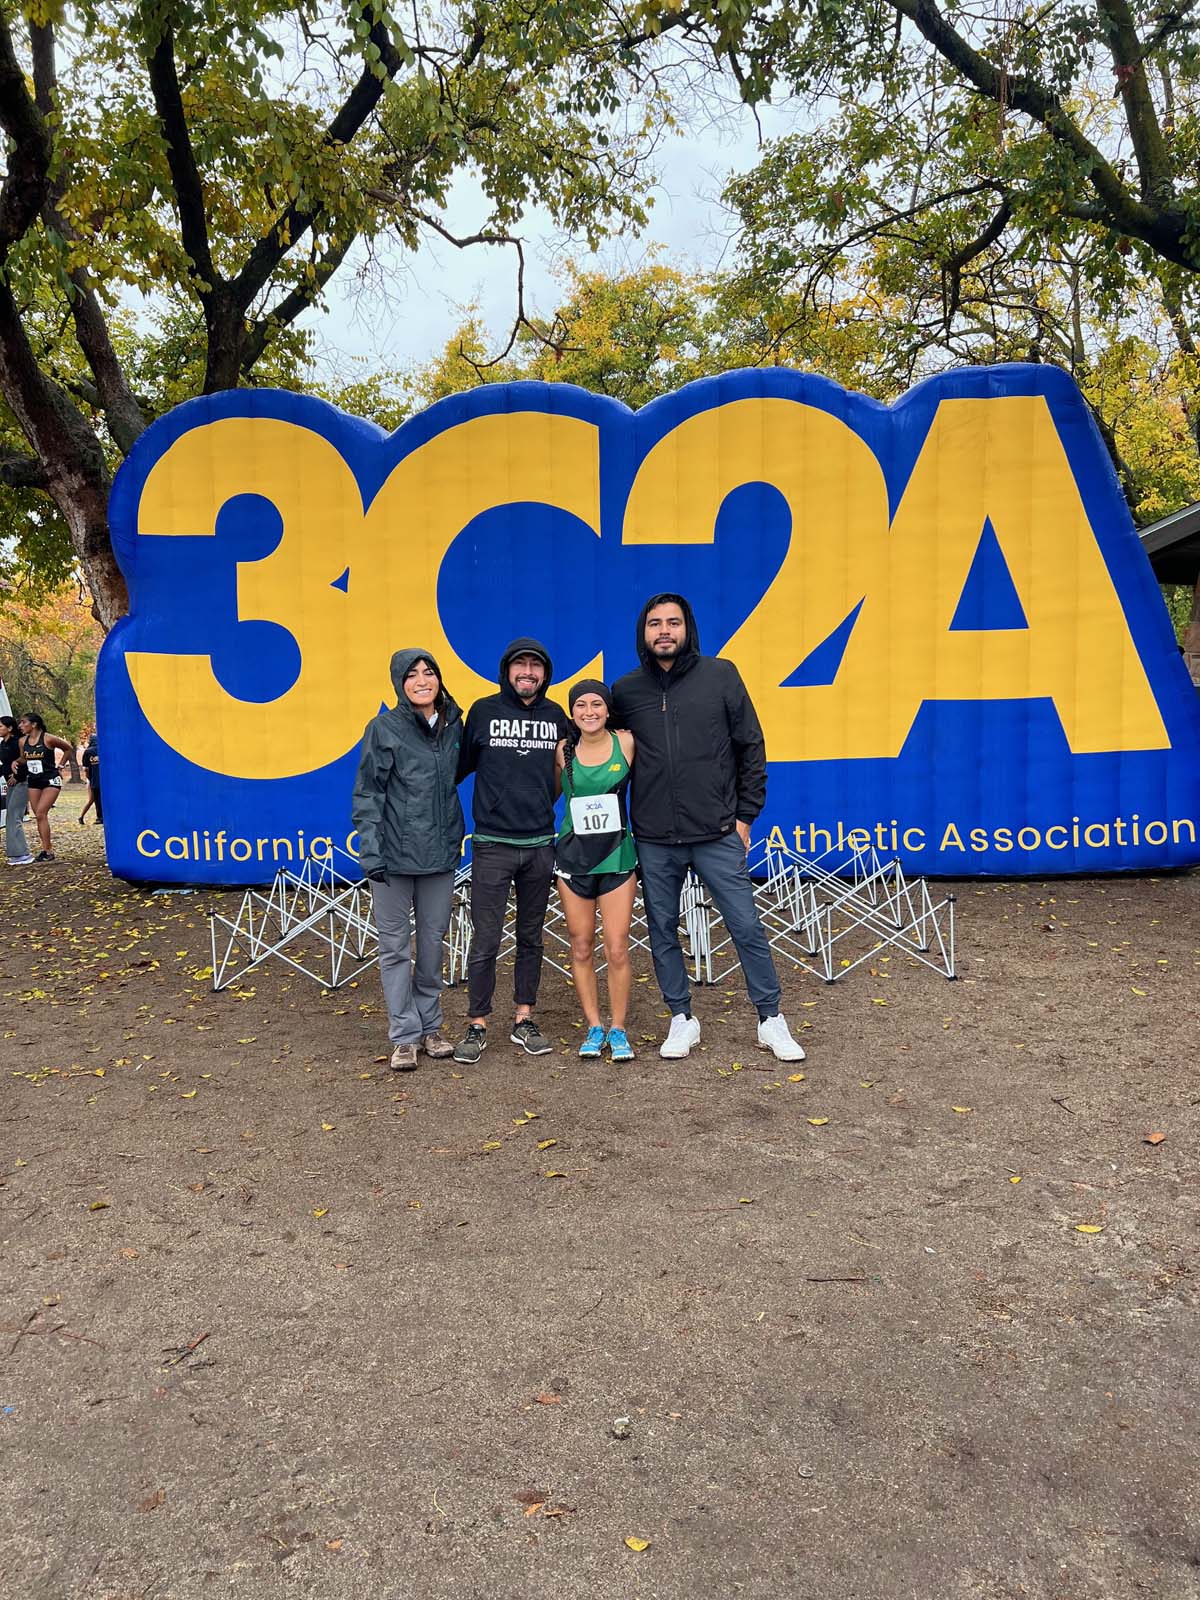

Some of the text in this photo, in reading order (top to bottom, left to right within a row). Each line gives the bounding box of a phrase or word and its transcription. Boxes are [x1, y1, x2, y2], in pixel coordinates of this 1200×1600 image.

[124, 394, 1172, 780] 3C2A
[489, 719, 558, 740] CRAFTON
[489, 738, 558, 750] CROSS COUNTRY
[583, 813, 609, 831] 107
[765, 814, 1196, 854] Athletic Association
[136, 829, 333, 861] California
